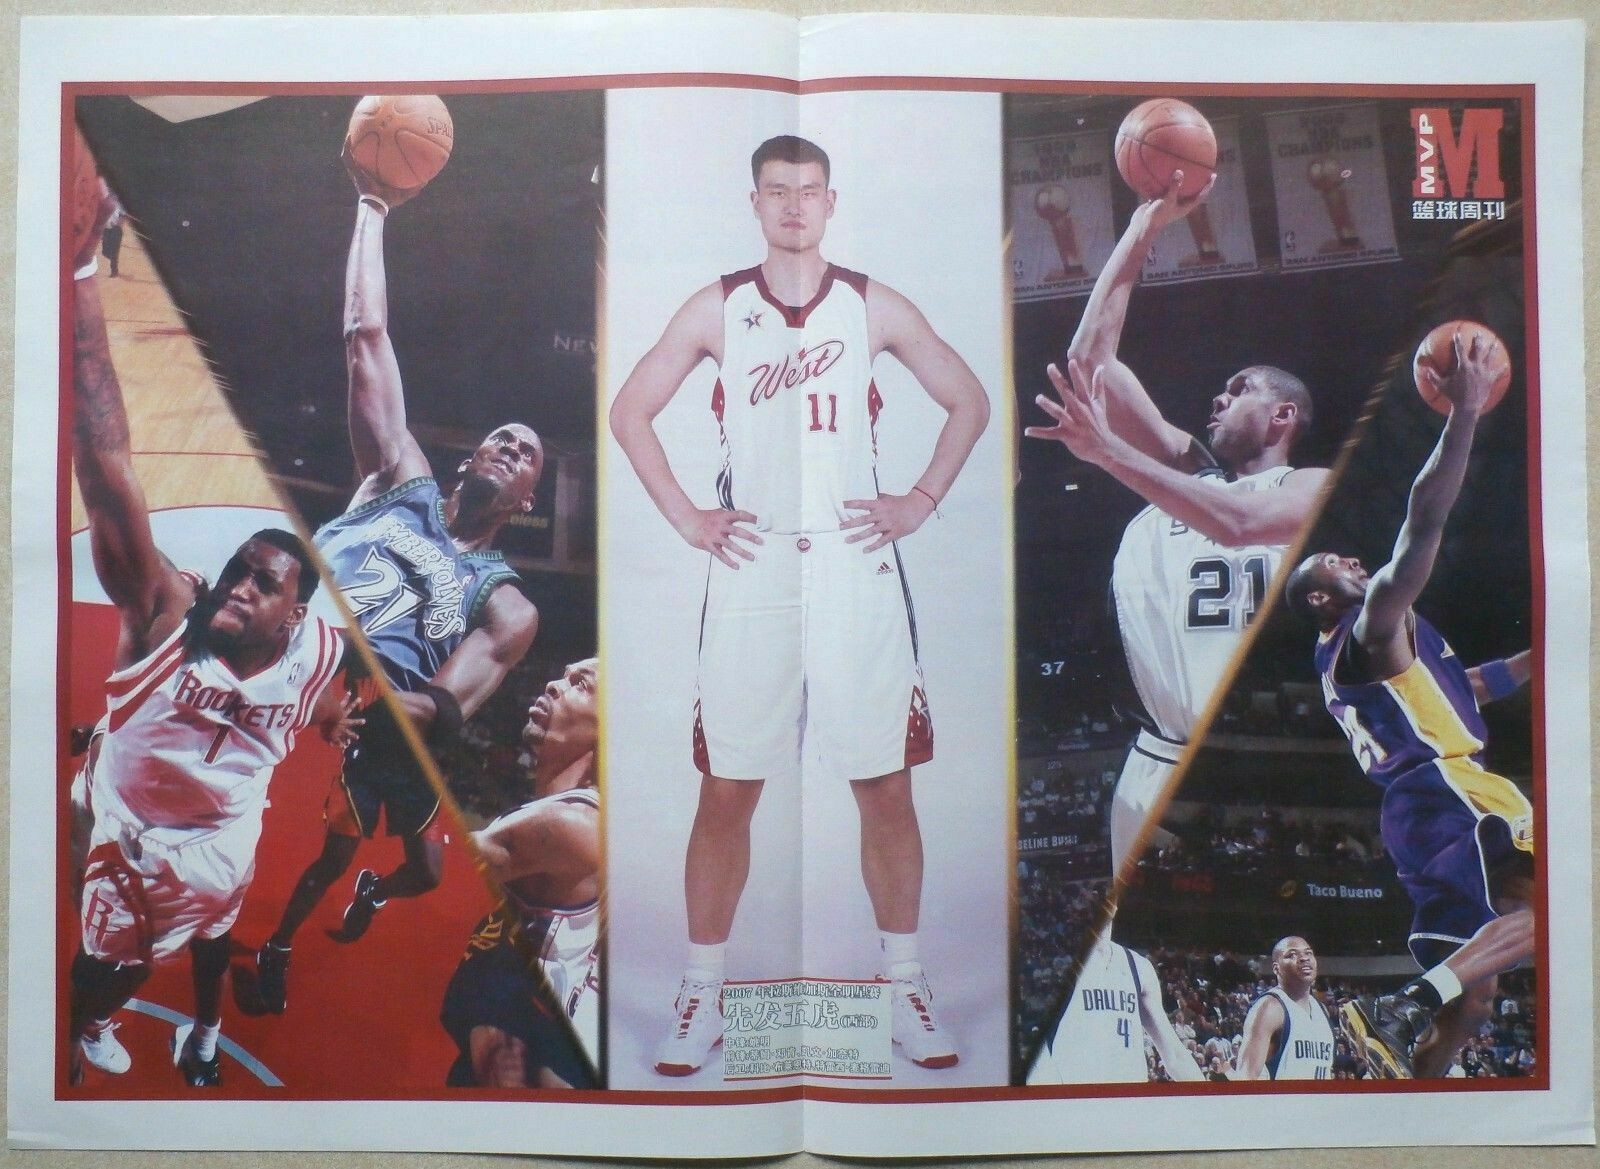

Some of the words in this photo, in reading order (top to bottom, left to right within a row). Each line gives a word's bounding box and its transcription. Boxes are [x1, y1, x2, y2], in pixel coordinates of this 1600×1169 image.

[1419, 113, 1435, 194] MVP
[1412, 200, 1505, 220] 篮球周刊
[748, 340, 844, 407] West
[807, 393, 837, 432] 11
[1184, 555, 1271, 632] 21
[1041, 661, 1065, 676] 37
[174, 670, 296, 730] ROCKETS
[1307, 883, 1337, 898] Taco
[1340, 885, 1383, 899] Bueno
[724, 987, 754, 1000] 2007
[1082, 988, 1136, 1014] DALLAS
[1116, 1017, 1130, 1048] 4
[1294, 1040, 1331, 1061] DALLAS
